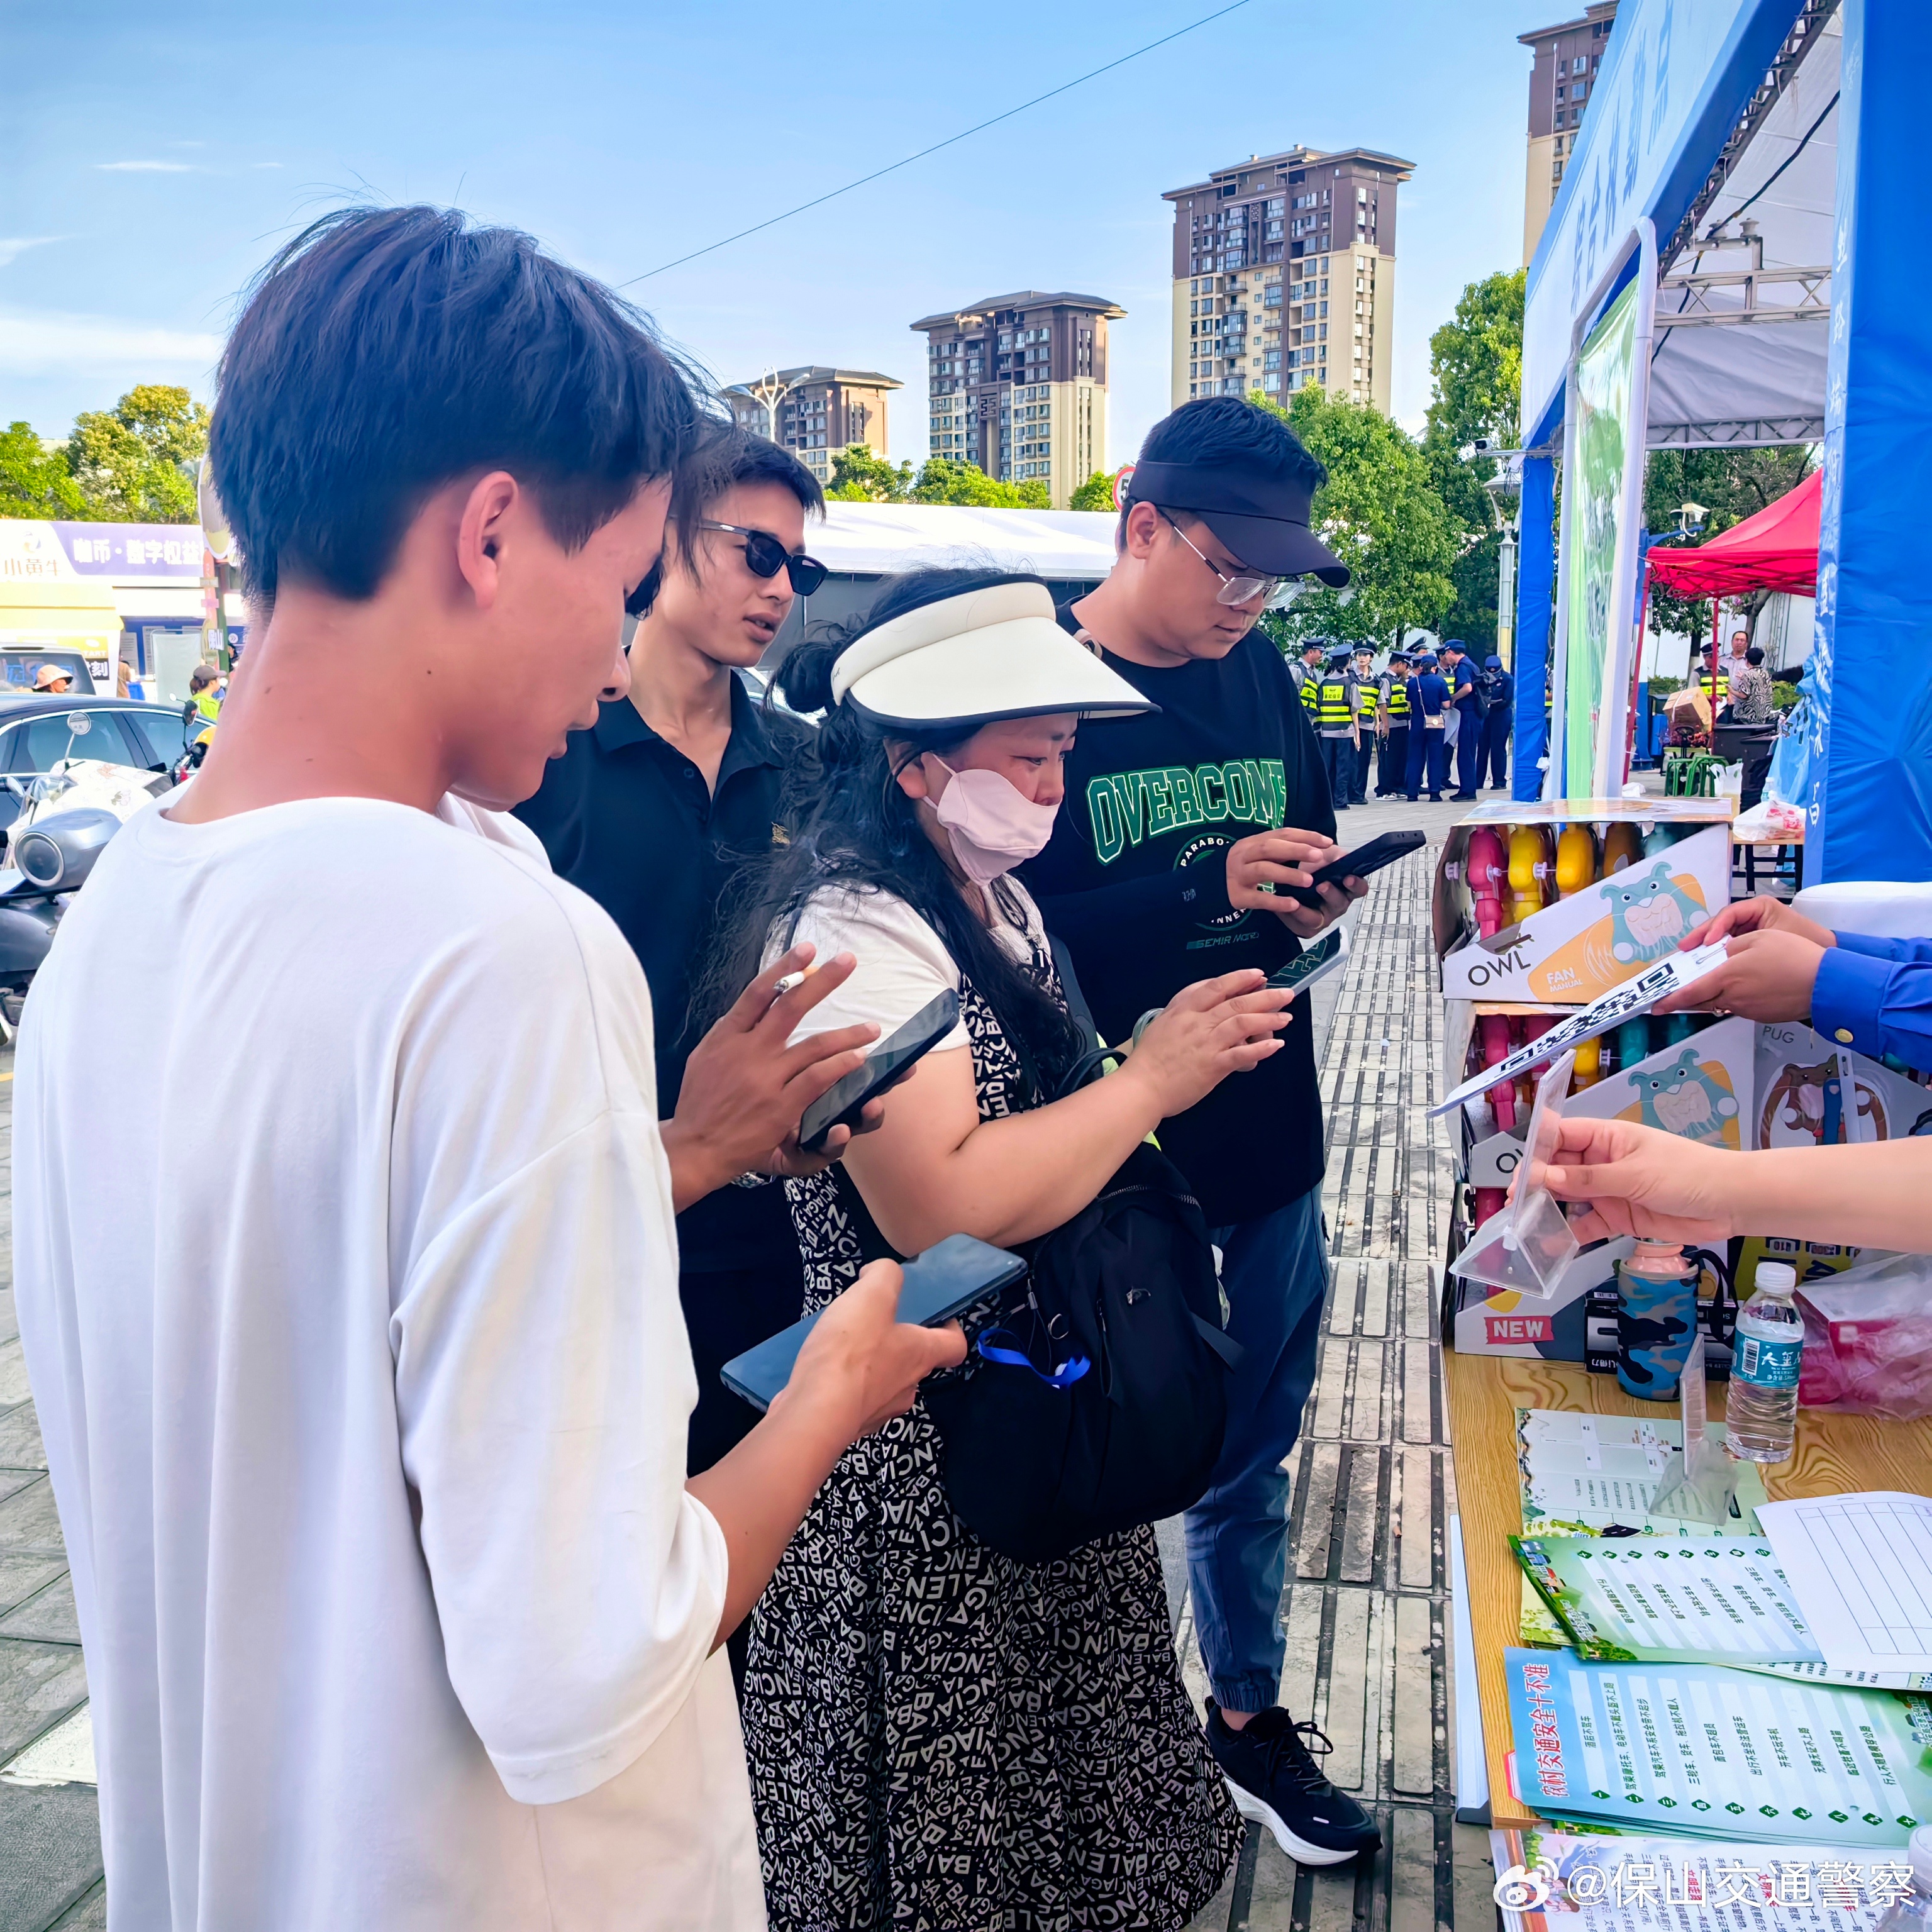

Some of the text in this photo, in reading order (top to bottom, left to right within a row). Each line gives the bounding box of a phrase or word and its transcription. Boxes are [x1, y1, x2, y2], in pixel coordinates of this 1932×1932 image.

[3, 558, 62, 576] 小黄牛
[1086, 758, 1287, 865] OVERCOME
[1180, 837, 1230, 867] PARABO
[1468, 950, 1531, 986] OWL
[1546, 967, 1575, 985] FAN
[1550, 979, 1584, 992] MANUAL
[1763, 1026, 1795, 1045] PUG
[1493, 1319, 1543, 1338] NEW
[1523, 1663, 1570, 1797] 农村交通安全十不准
[1580, 1715, 1597, 1748] 酒后不驾车
[1636, 1698, 1667, 1779] 驾乘汽车不系安全带不起步
[1667, 1697, 1701, 1785] 三轮车、货车、拖拉机不载人
[1703, 1723, 1727, 1762] 面包车不超员
[1733, 1715, 1762, 1776] 出行不坐非法营运车
[1767, 1728, 1792, 1768] 开车不玩手机
[1797, 1727, 1827, 1774] 无牌无证不上路
[1859, 1725, 1897, 1785] 行人不随意横穿公路
